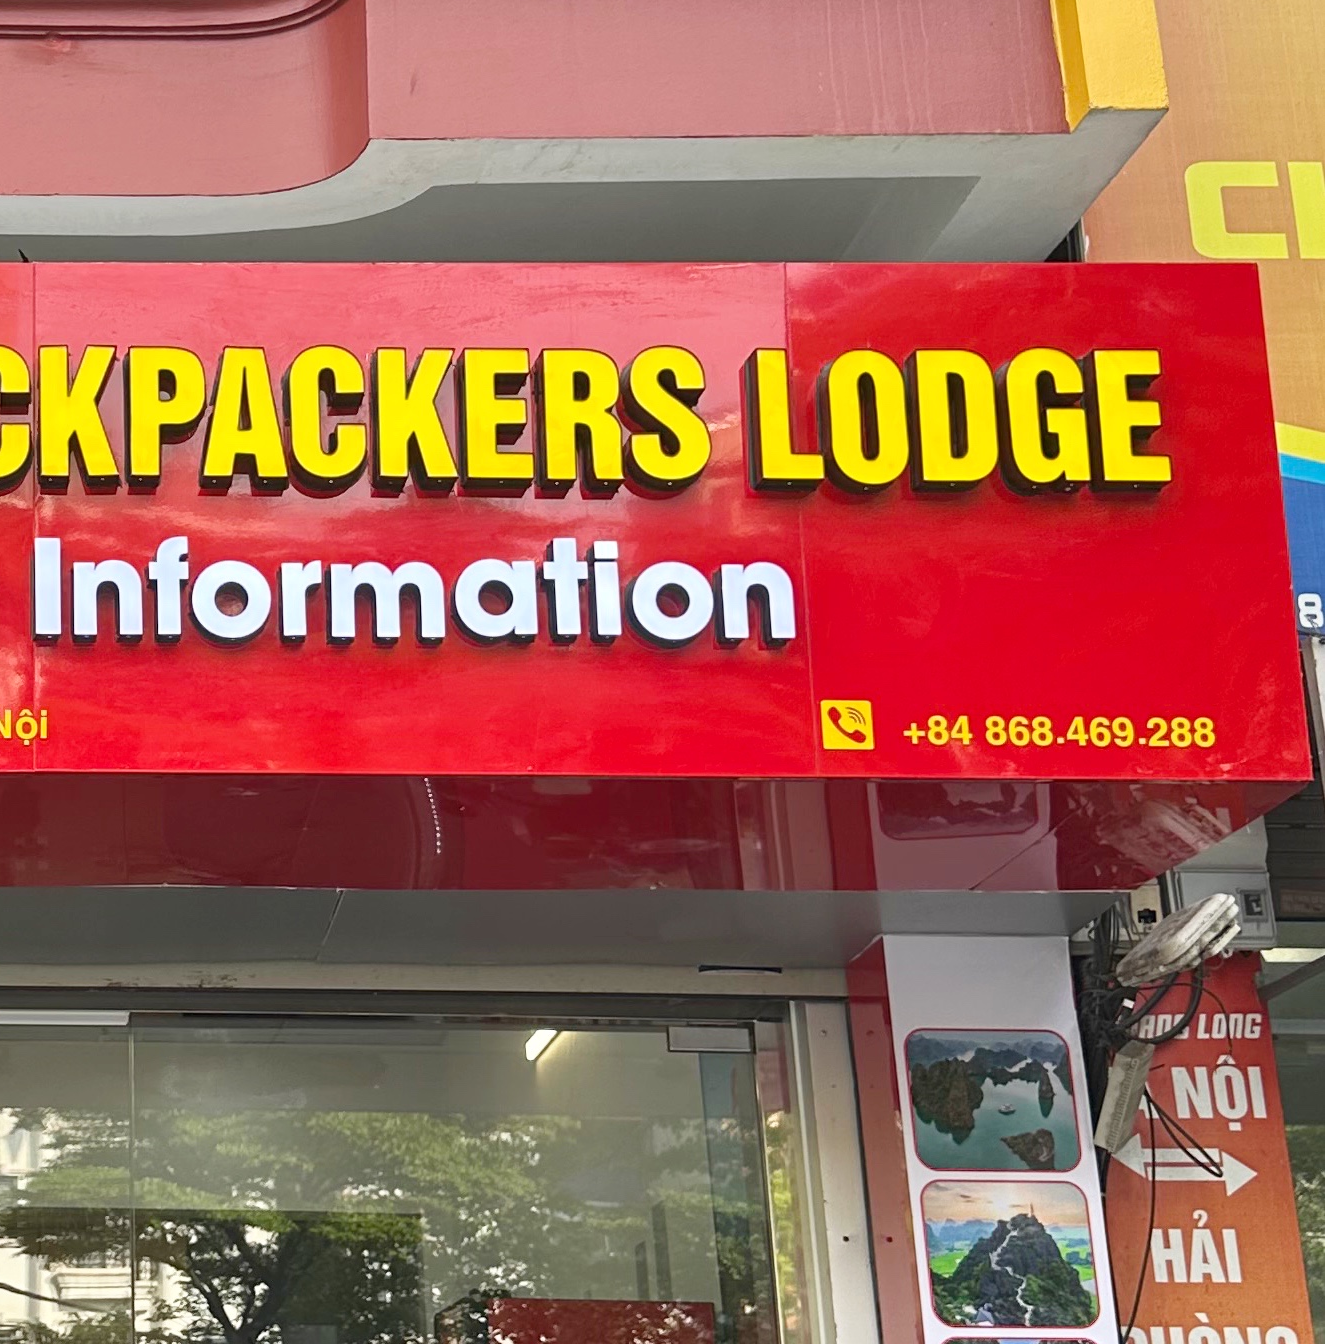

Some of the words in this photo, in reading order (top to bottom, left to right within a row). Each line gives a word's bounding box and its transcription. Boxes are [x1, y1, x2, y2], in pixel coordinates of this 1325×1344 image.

[753, 346, 1172, 488] LODGE
[33, 535, 797, 642] Information
[903, 718, 973, 746] +84
[985, 715, 1216, 748] 868.469.288
[1196, 1013, 1263, 1040] LONG
[1170, 1054, 1268, 1132] NỘI
[1150, 1209, 1243, 1284] HẢI
